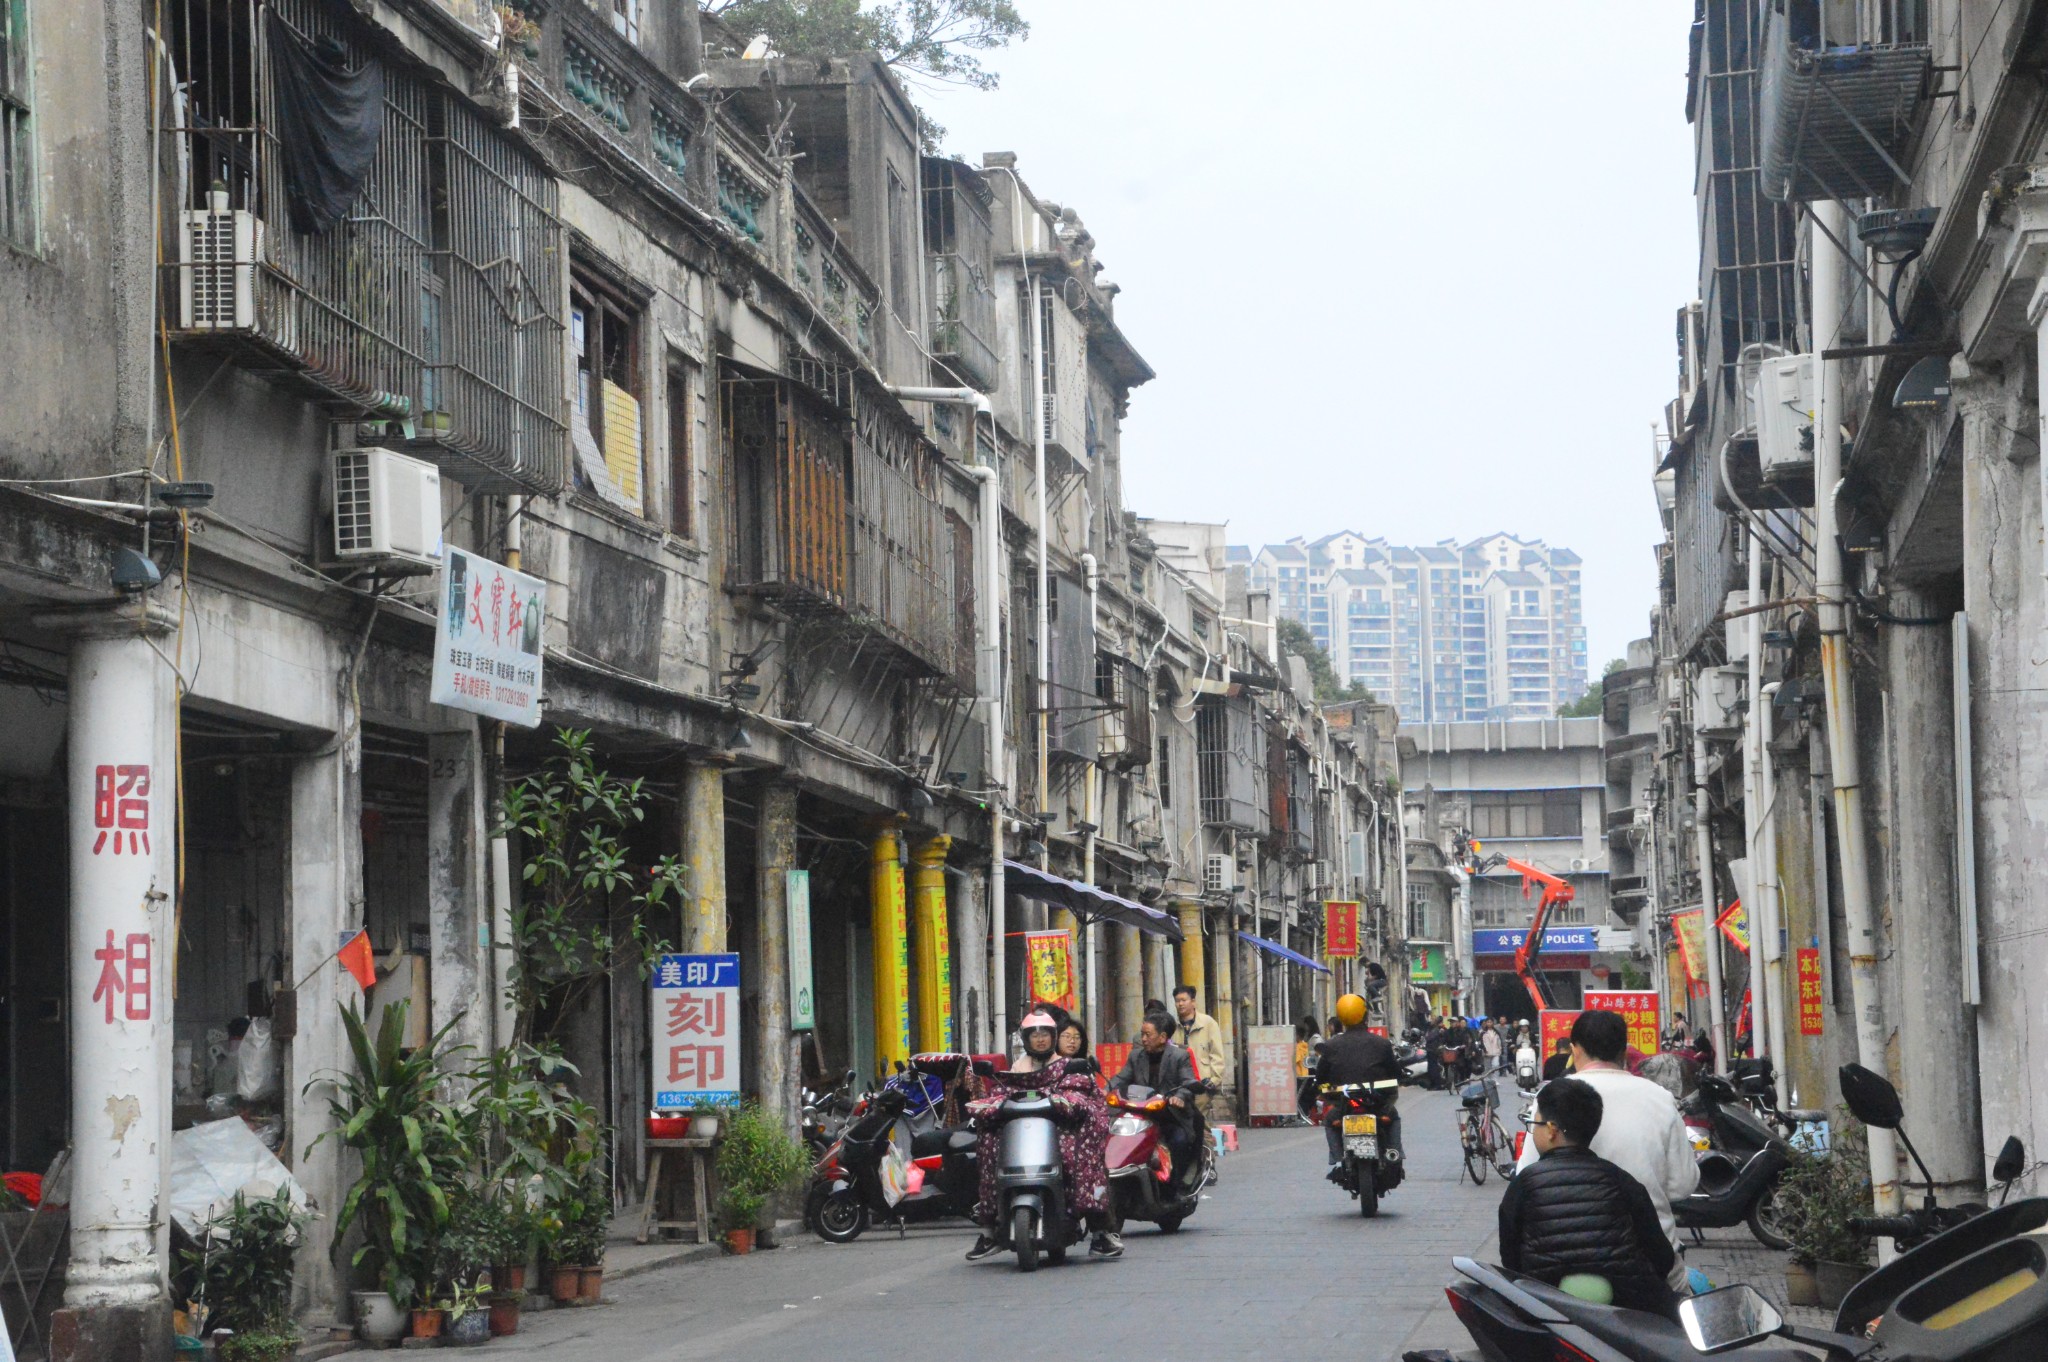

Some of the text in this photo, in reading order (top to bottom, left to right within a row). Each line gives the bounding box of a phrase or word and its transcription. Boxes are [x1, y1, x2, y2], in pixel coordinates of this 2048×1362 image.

[92, 764, 151, 1024] 照相
[1498, 934, 1585, 945] 公安 POLICE
[661, 961, 734, 987] 美印厂
[1590, 996, 1650, 1009] 中山路老店
[1803, 1017, 1824, 1029] 1530
[666, 992, 726, 1089] 刻印
[1254, 1044, 1288, 1088] 蚝烙
